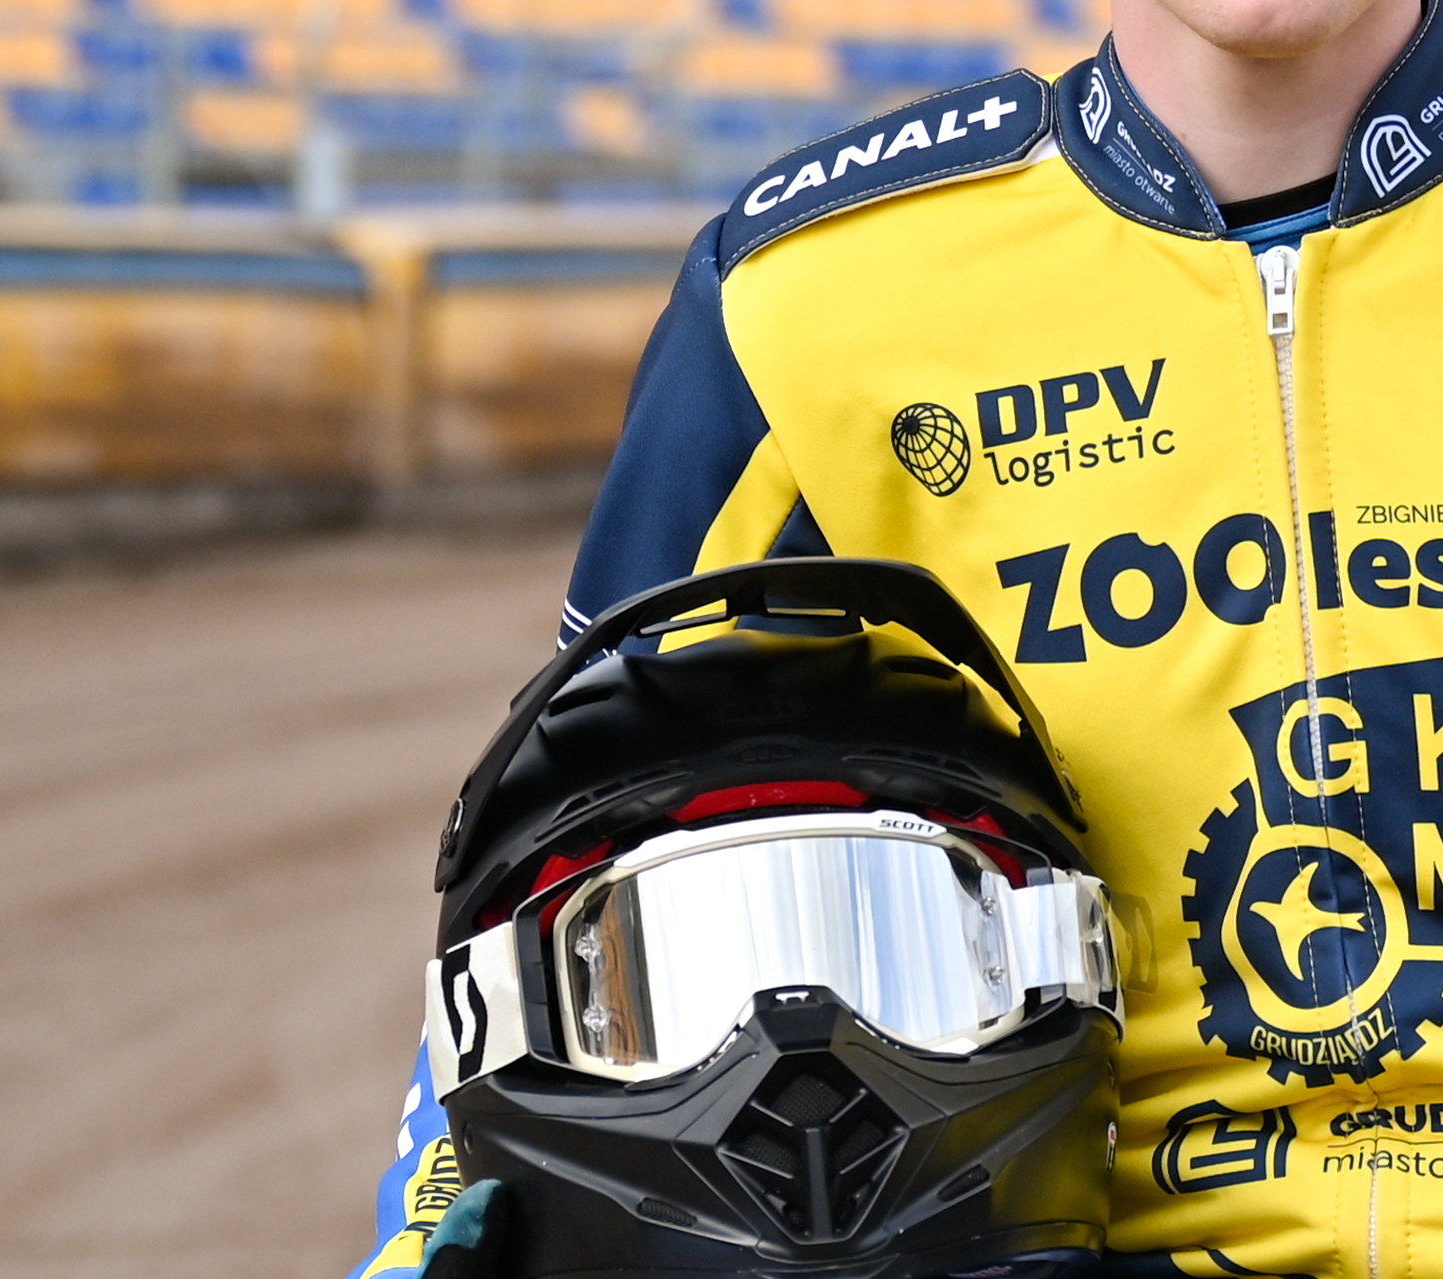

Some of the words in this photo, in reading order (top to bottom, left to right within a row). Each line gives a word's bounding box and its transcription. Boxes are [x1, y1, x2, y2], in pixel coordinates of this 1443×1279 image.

[743, 96, 1018, 217] CANAL+
[1103, 145, 1135, 177] miasto
[976, 357, 1167, 449] DPV
[983, 424, 1176, 487] logistic
[879, 819, 934, 833] SCOTT
[1250, 1007, 1394, 1066] GRUDZIĄDZ
